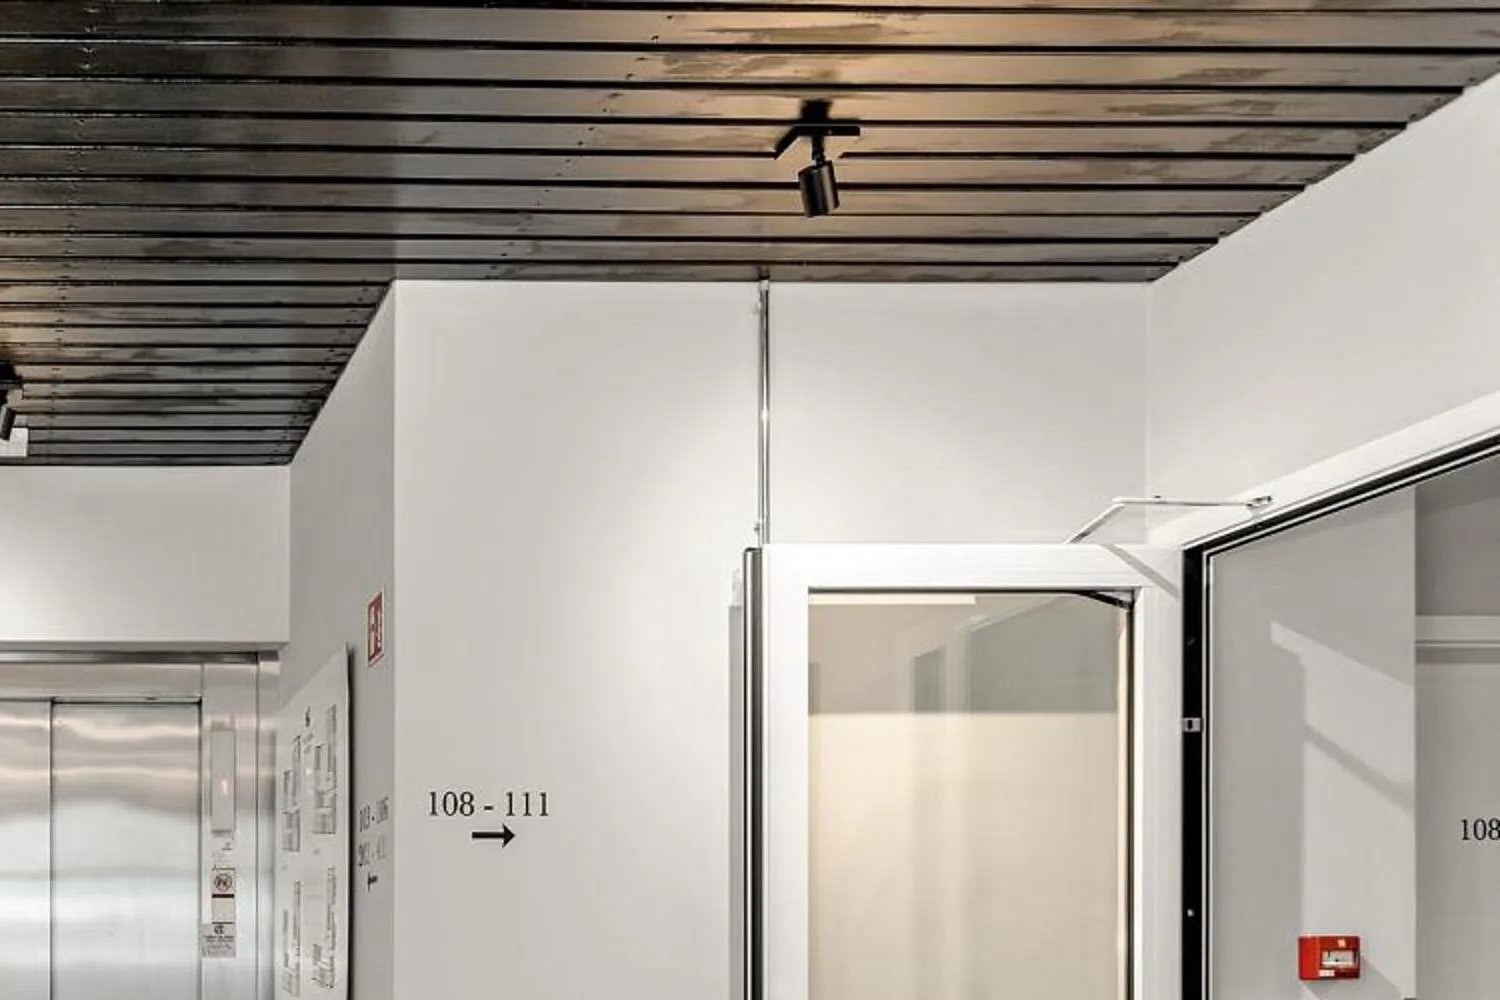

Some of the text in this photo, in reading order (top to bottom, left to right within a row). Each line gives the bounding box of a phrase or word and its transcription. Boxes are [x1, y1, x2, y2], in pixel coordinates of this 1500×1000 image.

[429, 791, 475, 817] 108
[506, 791, 549, 817] 111
[1460, 817, 1500, 841] 108
